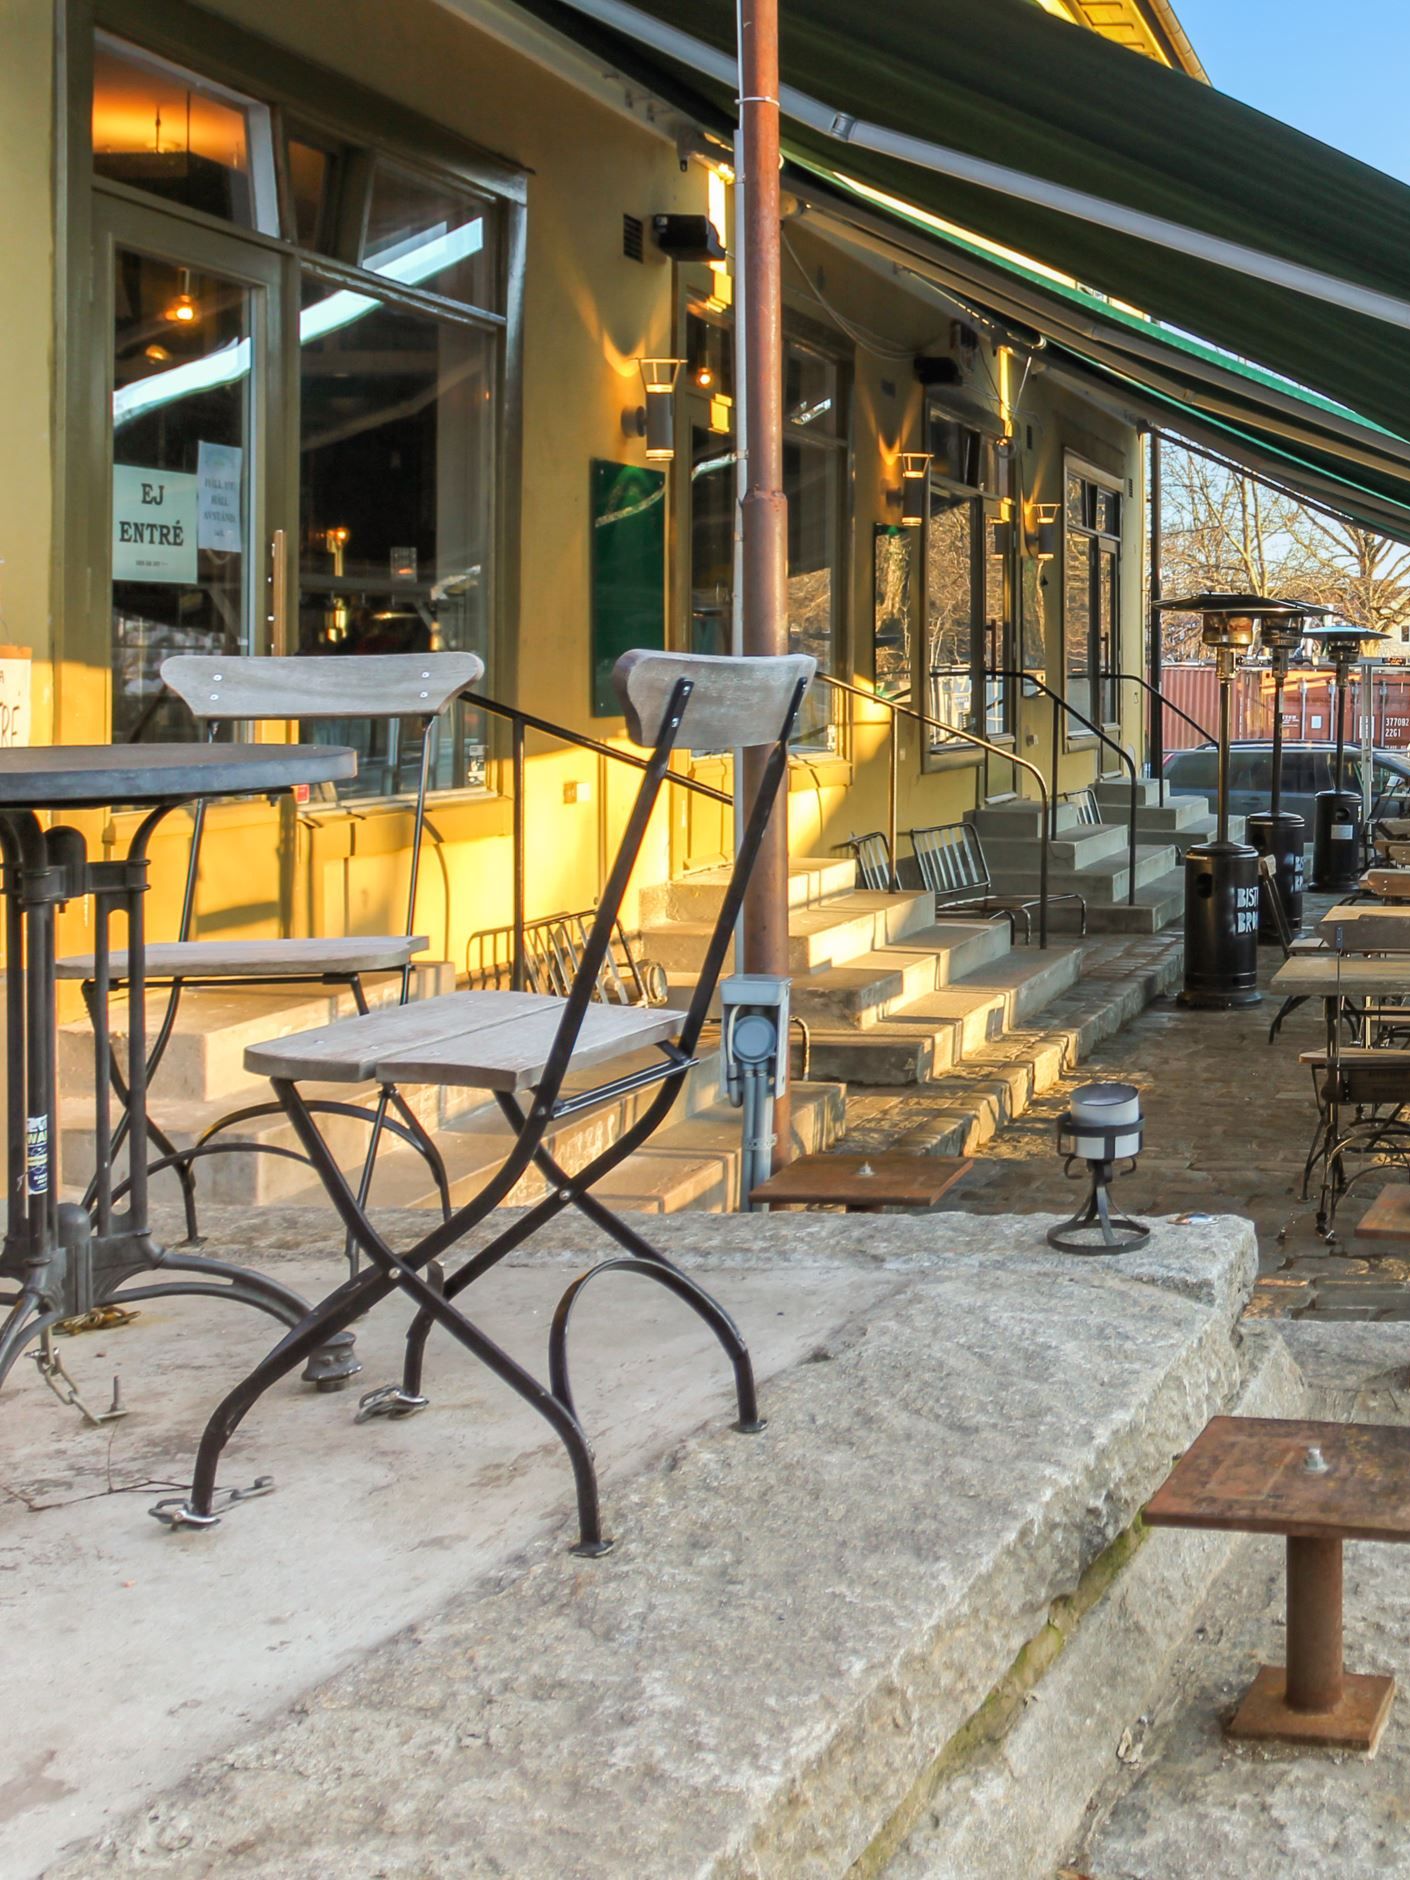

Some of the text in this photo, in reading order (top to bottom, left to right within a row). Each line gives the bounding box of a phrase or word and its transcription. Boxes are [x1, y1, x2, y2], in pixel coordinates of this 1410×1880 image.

[141, 483, 165, 505] EJ
[119, 520, 184, 546] ENTRÉ
[1236, 886, 1259, 908] BIST
[1237, 911, 1259, 933] BRO
